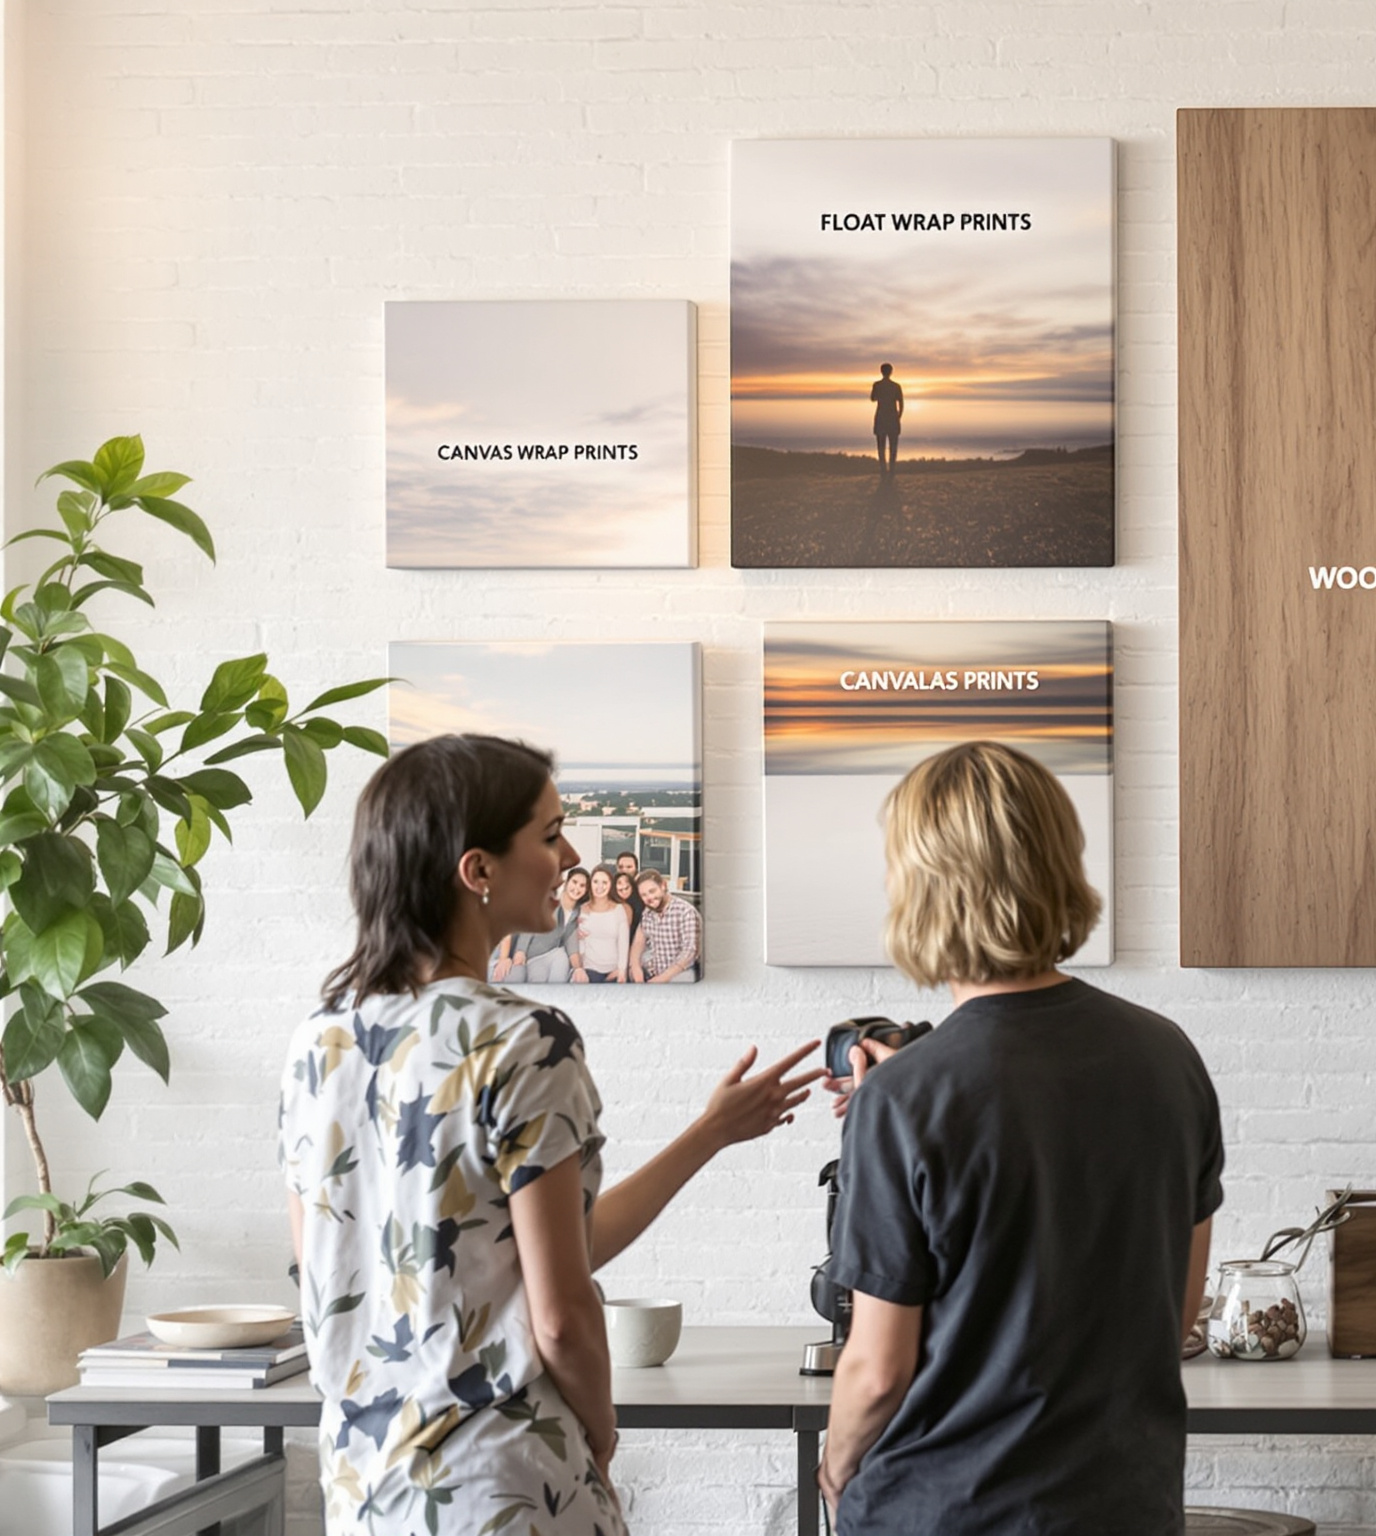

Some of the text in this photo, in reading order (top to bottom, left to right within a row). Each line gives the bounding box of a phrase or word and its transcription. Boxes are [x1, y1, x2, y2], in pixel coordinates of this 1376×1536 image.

[821, 213, 1032, 231] FLOAT WRAP PRINTS
[437, 444, 639, 461] CANVAS WRAP PRINTS
[839, 671, 1040, 691] CANVALAS PRINTS
